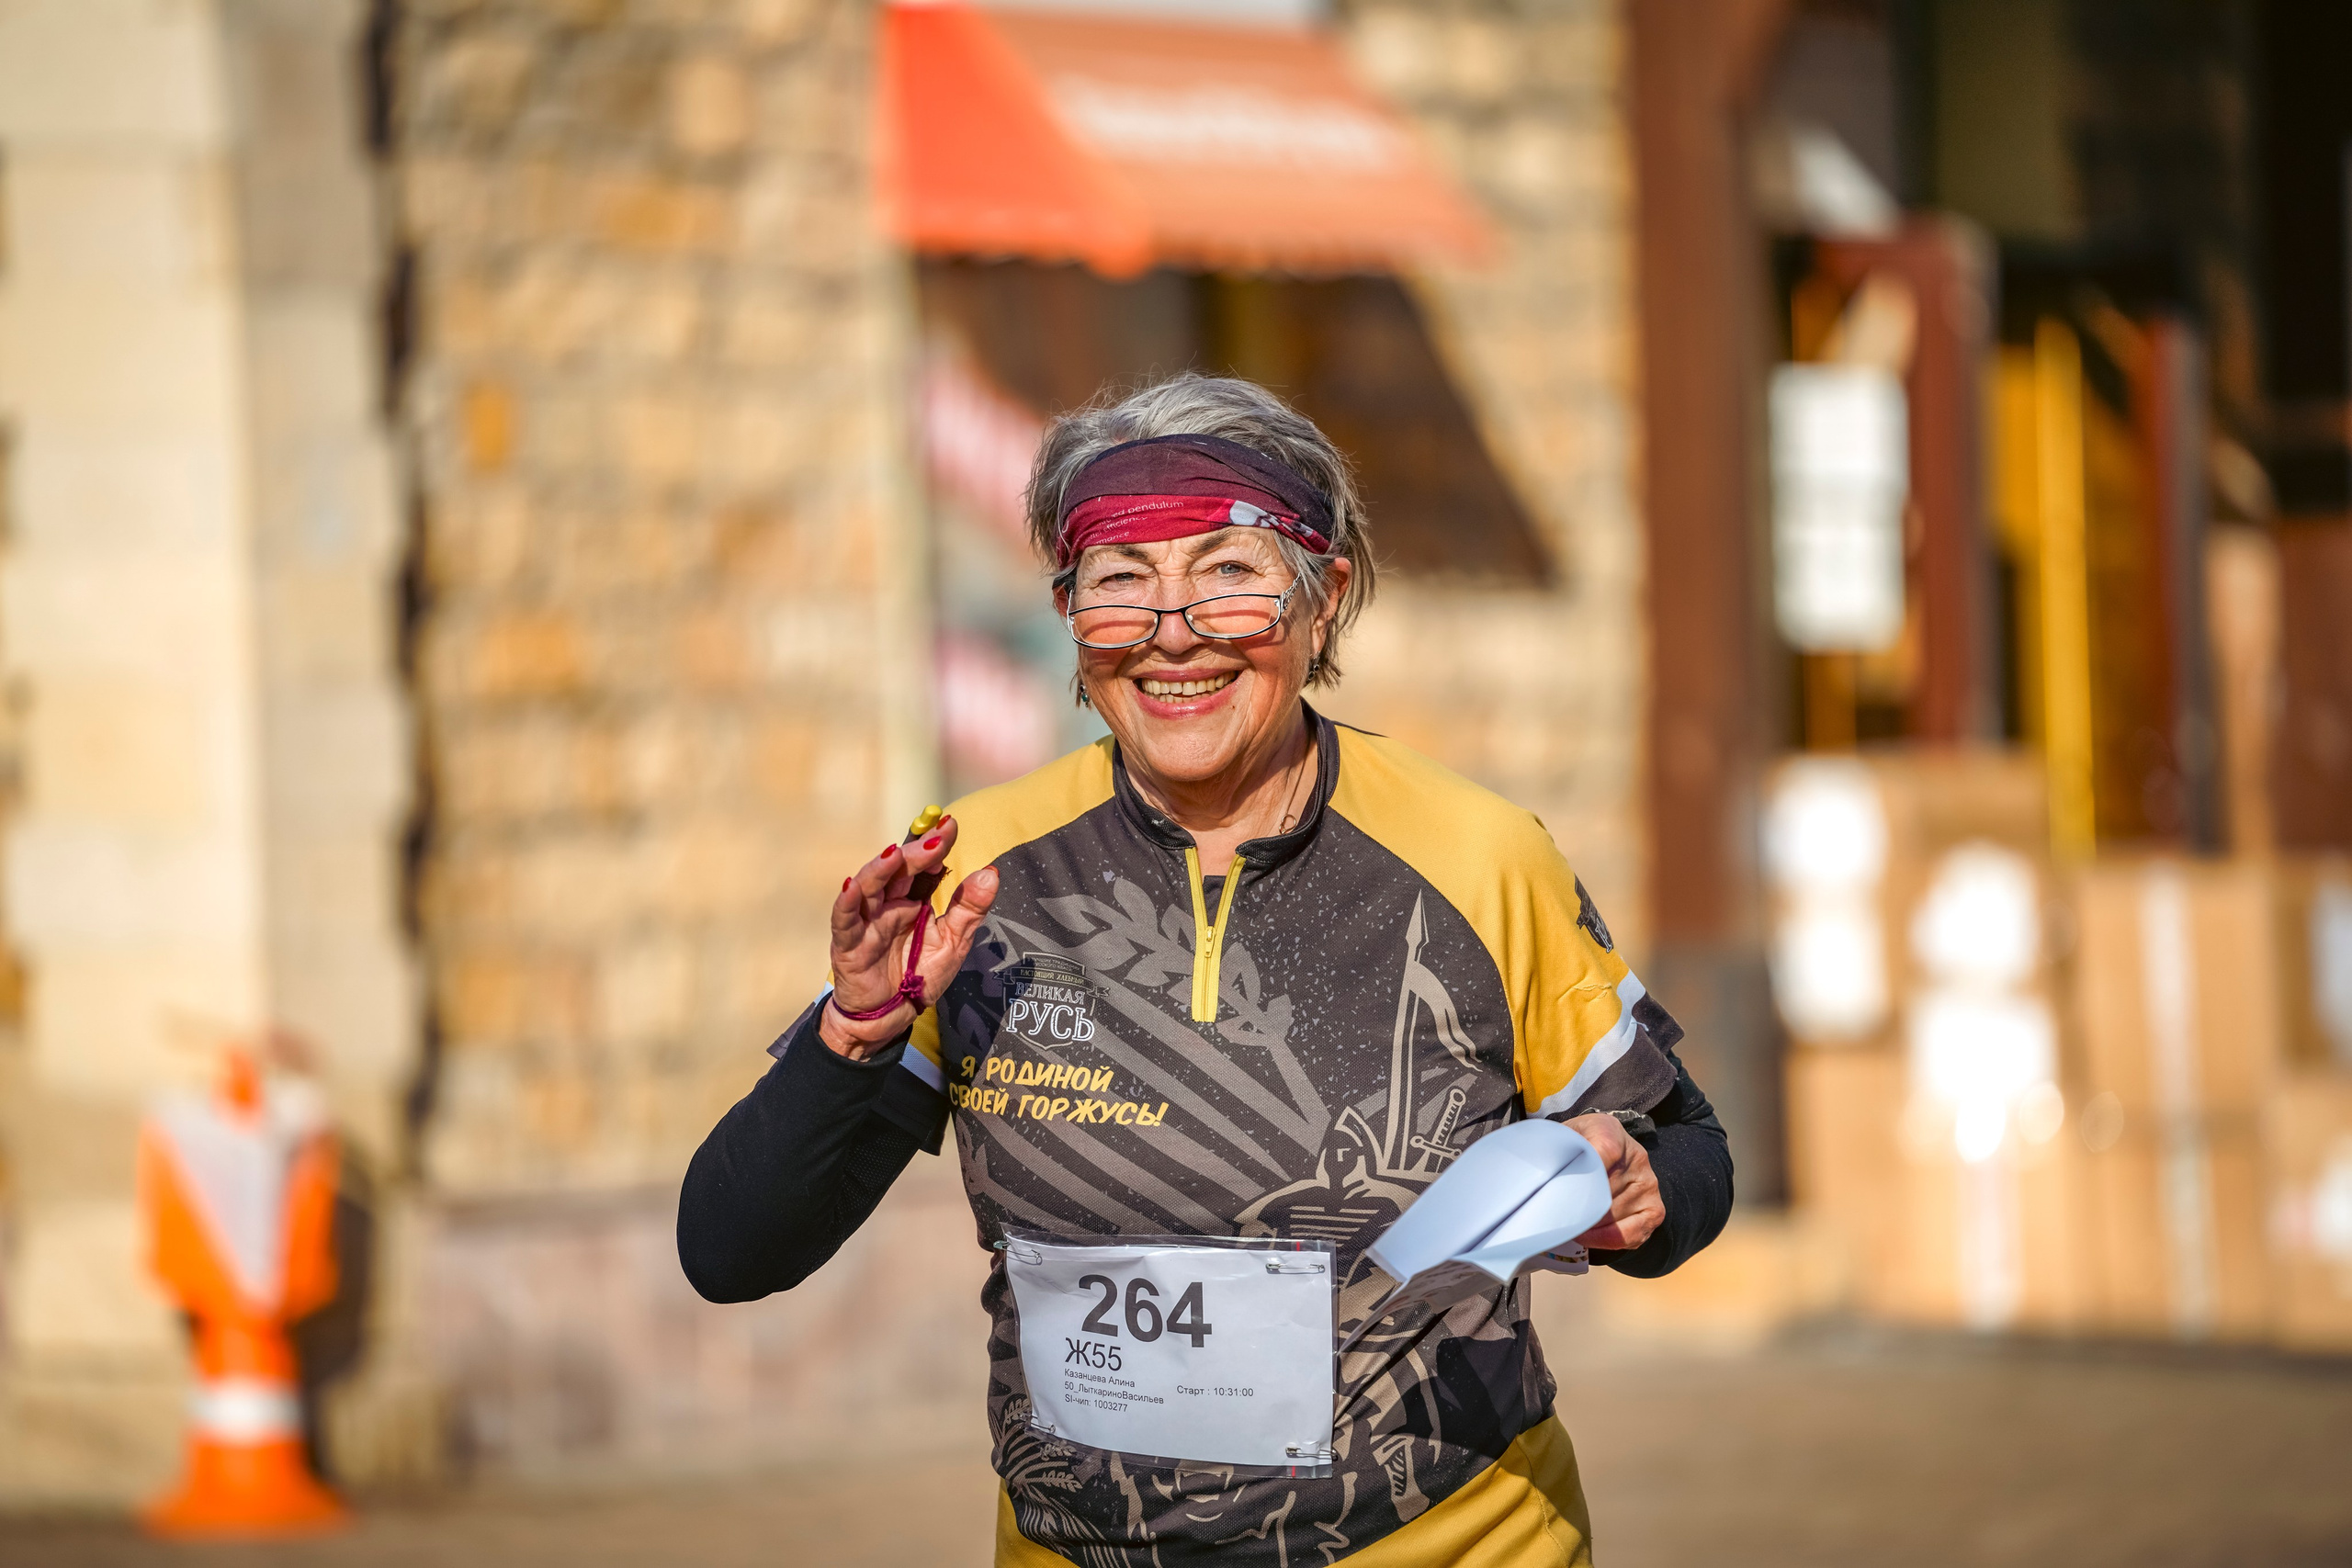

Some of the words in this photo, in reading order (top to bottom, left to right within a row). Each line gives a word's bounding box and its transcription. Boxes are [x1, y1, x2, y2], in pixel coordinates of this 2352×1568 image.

[1127, 501, 1184, 514] pendulum
[1014, 981, 1086, 1005] ВЕЛИКАЯ
[1006, 998, 1095, 1042] РУСЬ
[961, 1055, 976, 1078] Я
[986, 1056, 1115, 1093] РОДИНОЙ
[949, 1082, 1010, 1116] СВОЕЙ
[1017, 1094, 1170, 1127] ГОРЖУСЬ!
[1078, 1274, 1213, 1348] 264
[1065, 1337, 1123, 1371] Ж55
[1064, 1368, 1107, 1383] Казанцева
[1108, 1376, 1136, 1388] Алина
[1064, 1381, 1165, 1404] 50_ЛыткариноВасильев
[1176, 1384, 1205, 1396] Старт
[1213, 1387, 1254, 1397] 10:31:00
[1093, 1399, 1128, 1412] 1003277
